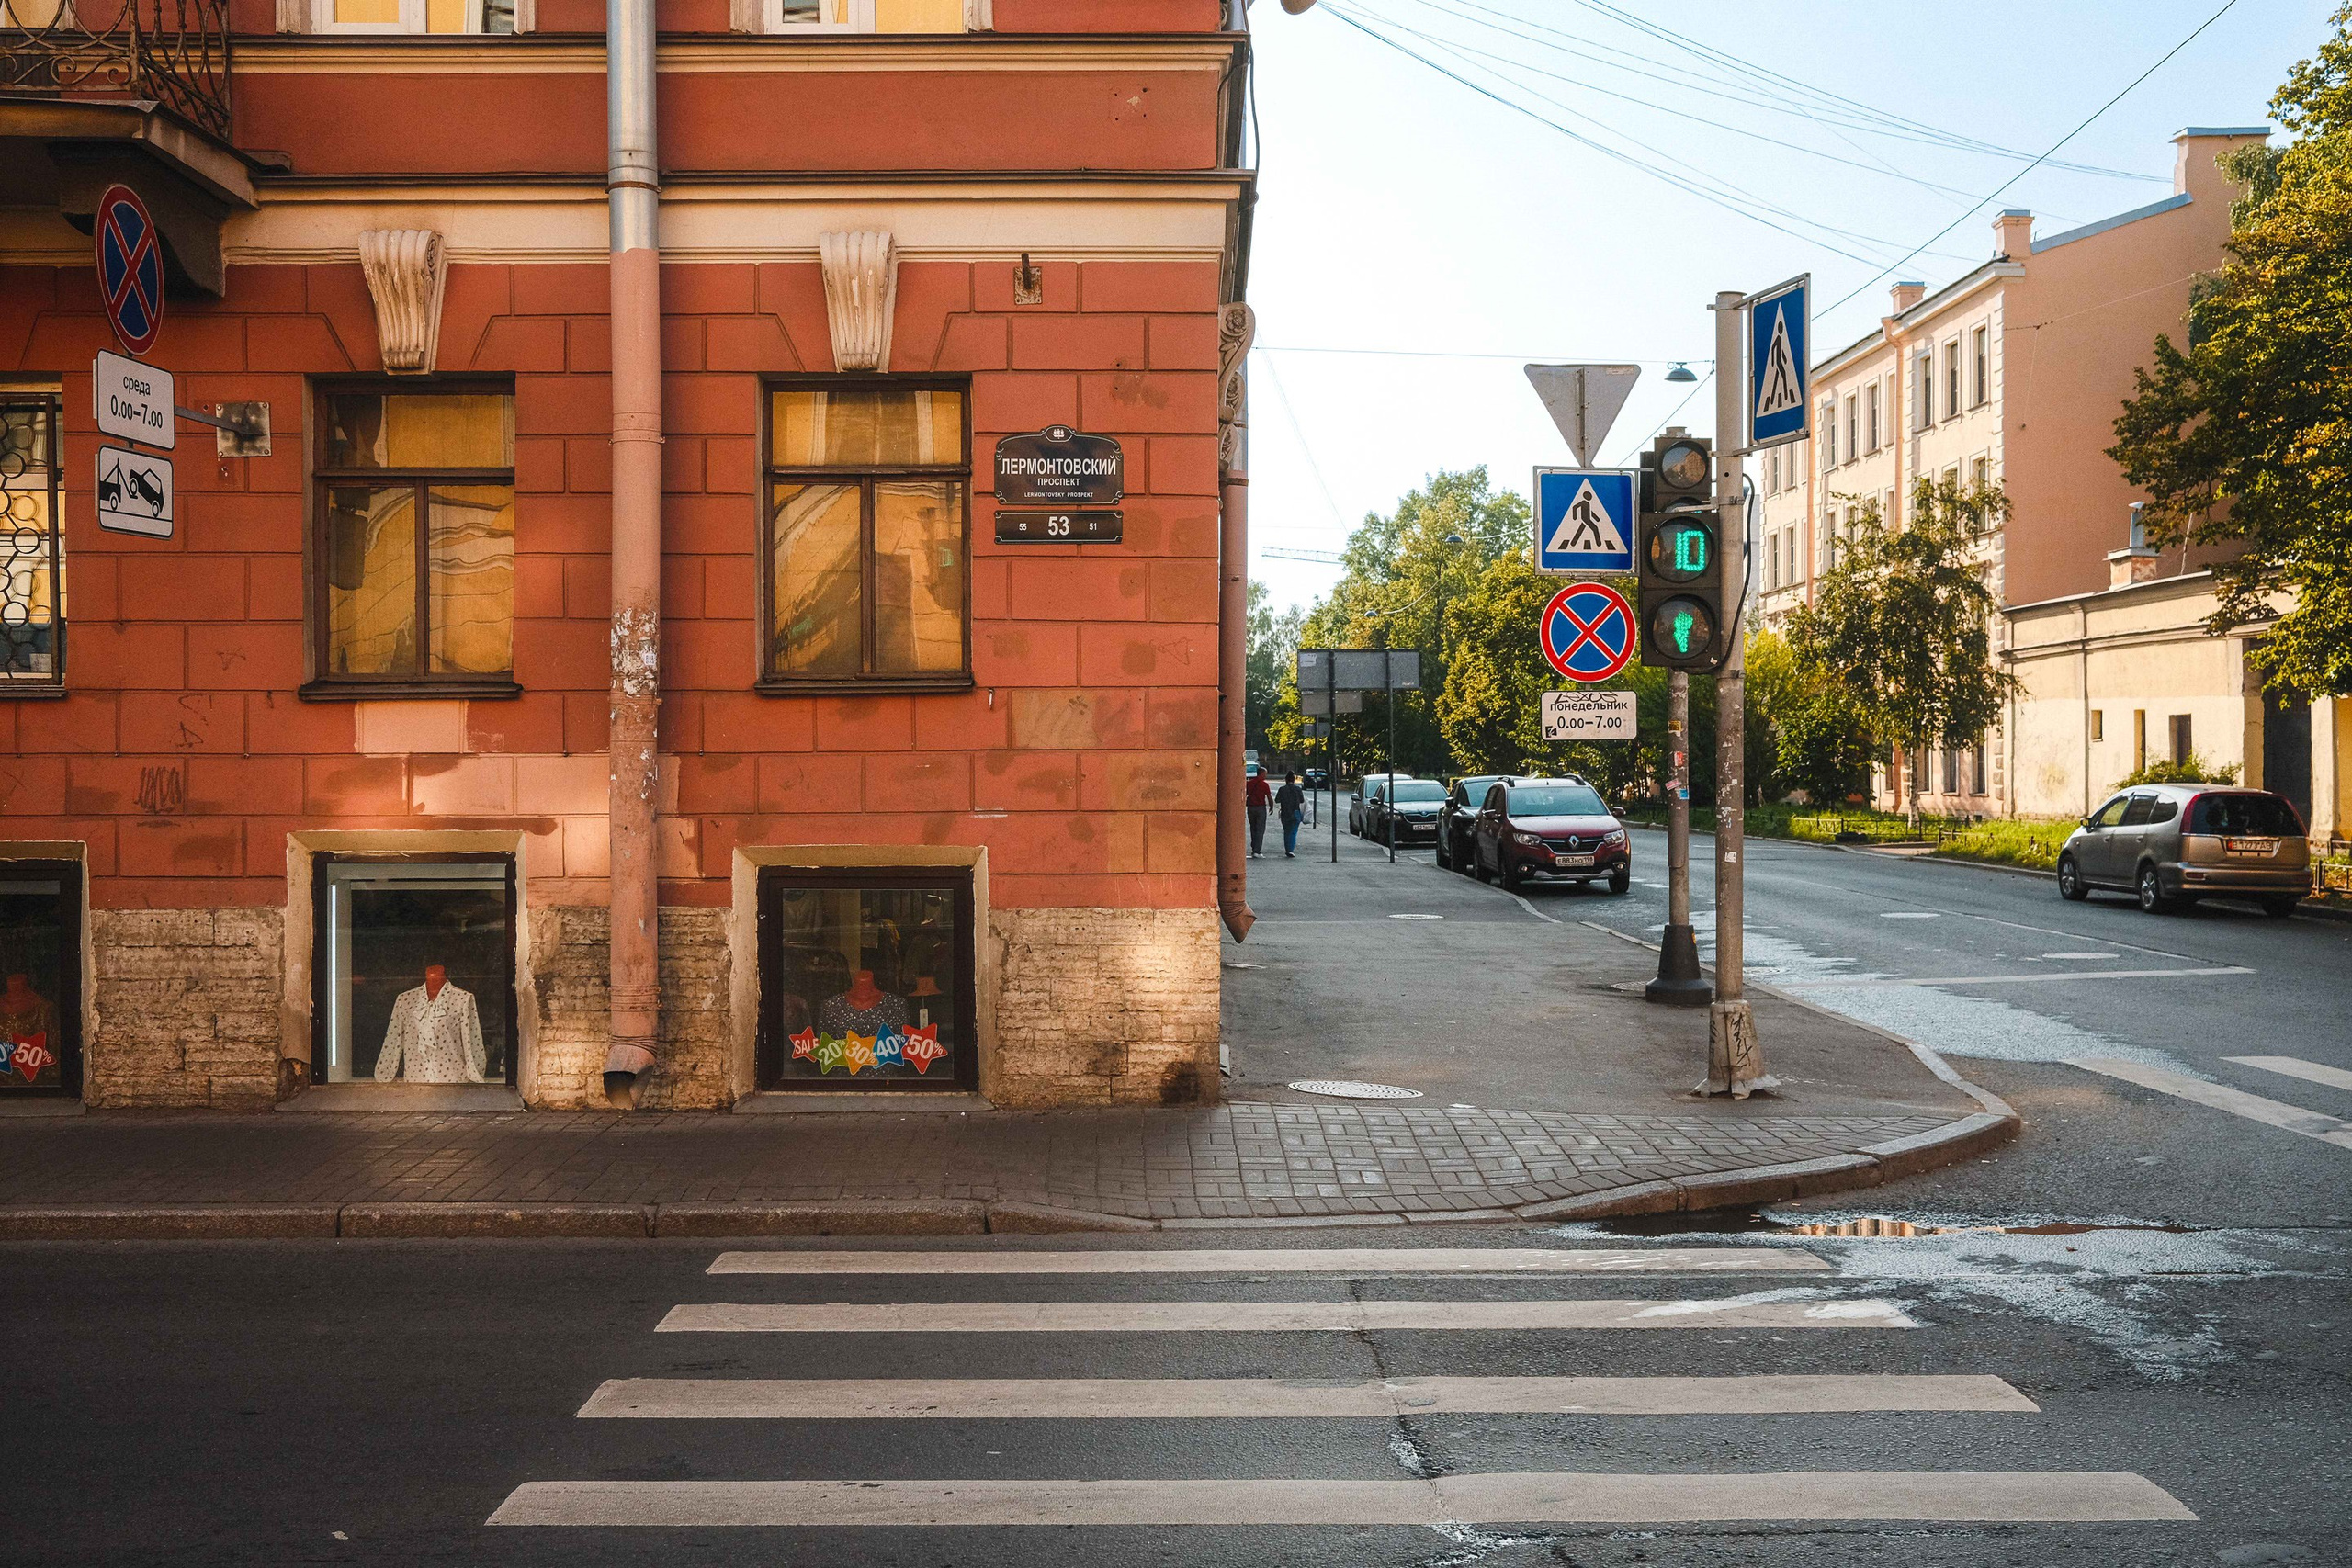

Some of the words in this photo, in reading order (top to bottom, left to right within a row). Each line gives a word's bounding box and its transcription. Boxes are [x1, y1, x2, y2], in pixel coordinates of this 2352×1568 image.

[123, 376, 151, 396] среда
[110, 394, 163, 429] 0.00-7.00
[1001, 455, 1116, 475] ЛЕРМОНТОВСКИЙ
[1037, 478, 1080, 486] ПРОСПЕКТ
[1019, 523, 1027, 531] 55
[1047, 515, 1069, 536] 53
[1089, 522, 1097, 530] 51
[1675, 530, 1705, 571] 10
[1550, 702, 1628, 712] понедельник
[1557, 716, 1622, 728] 0.00-7.00
[795, 1038, 820, 1055] SALE
